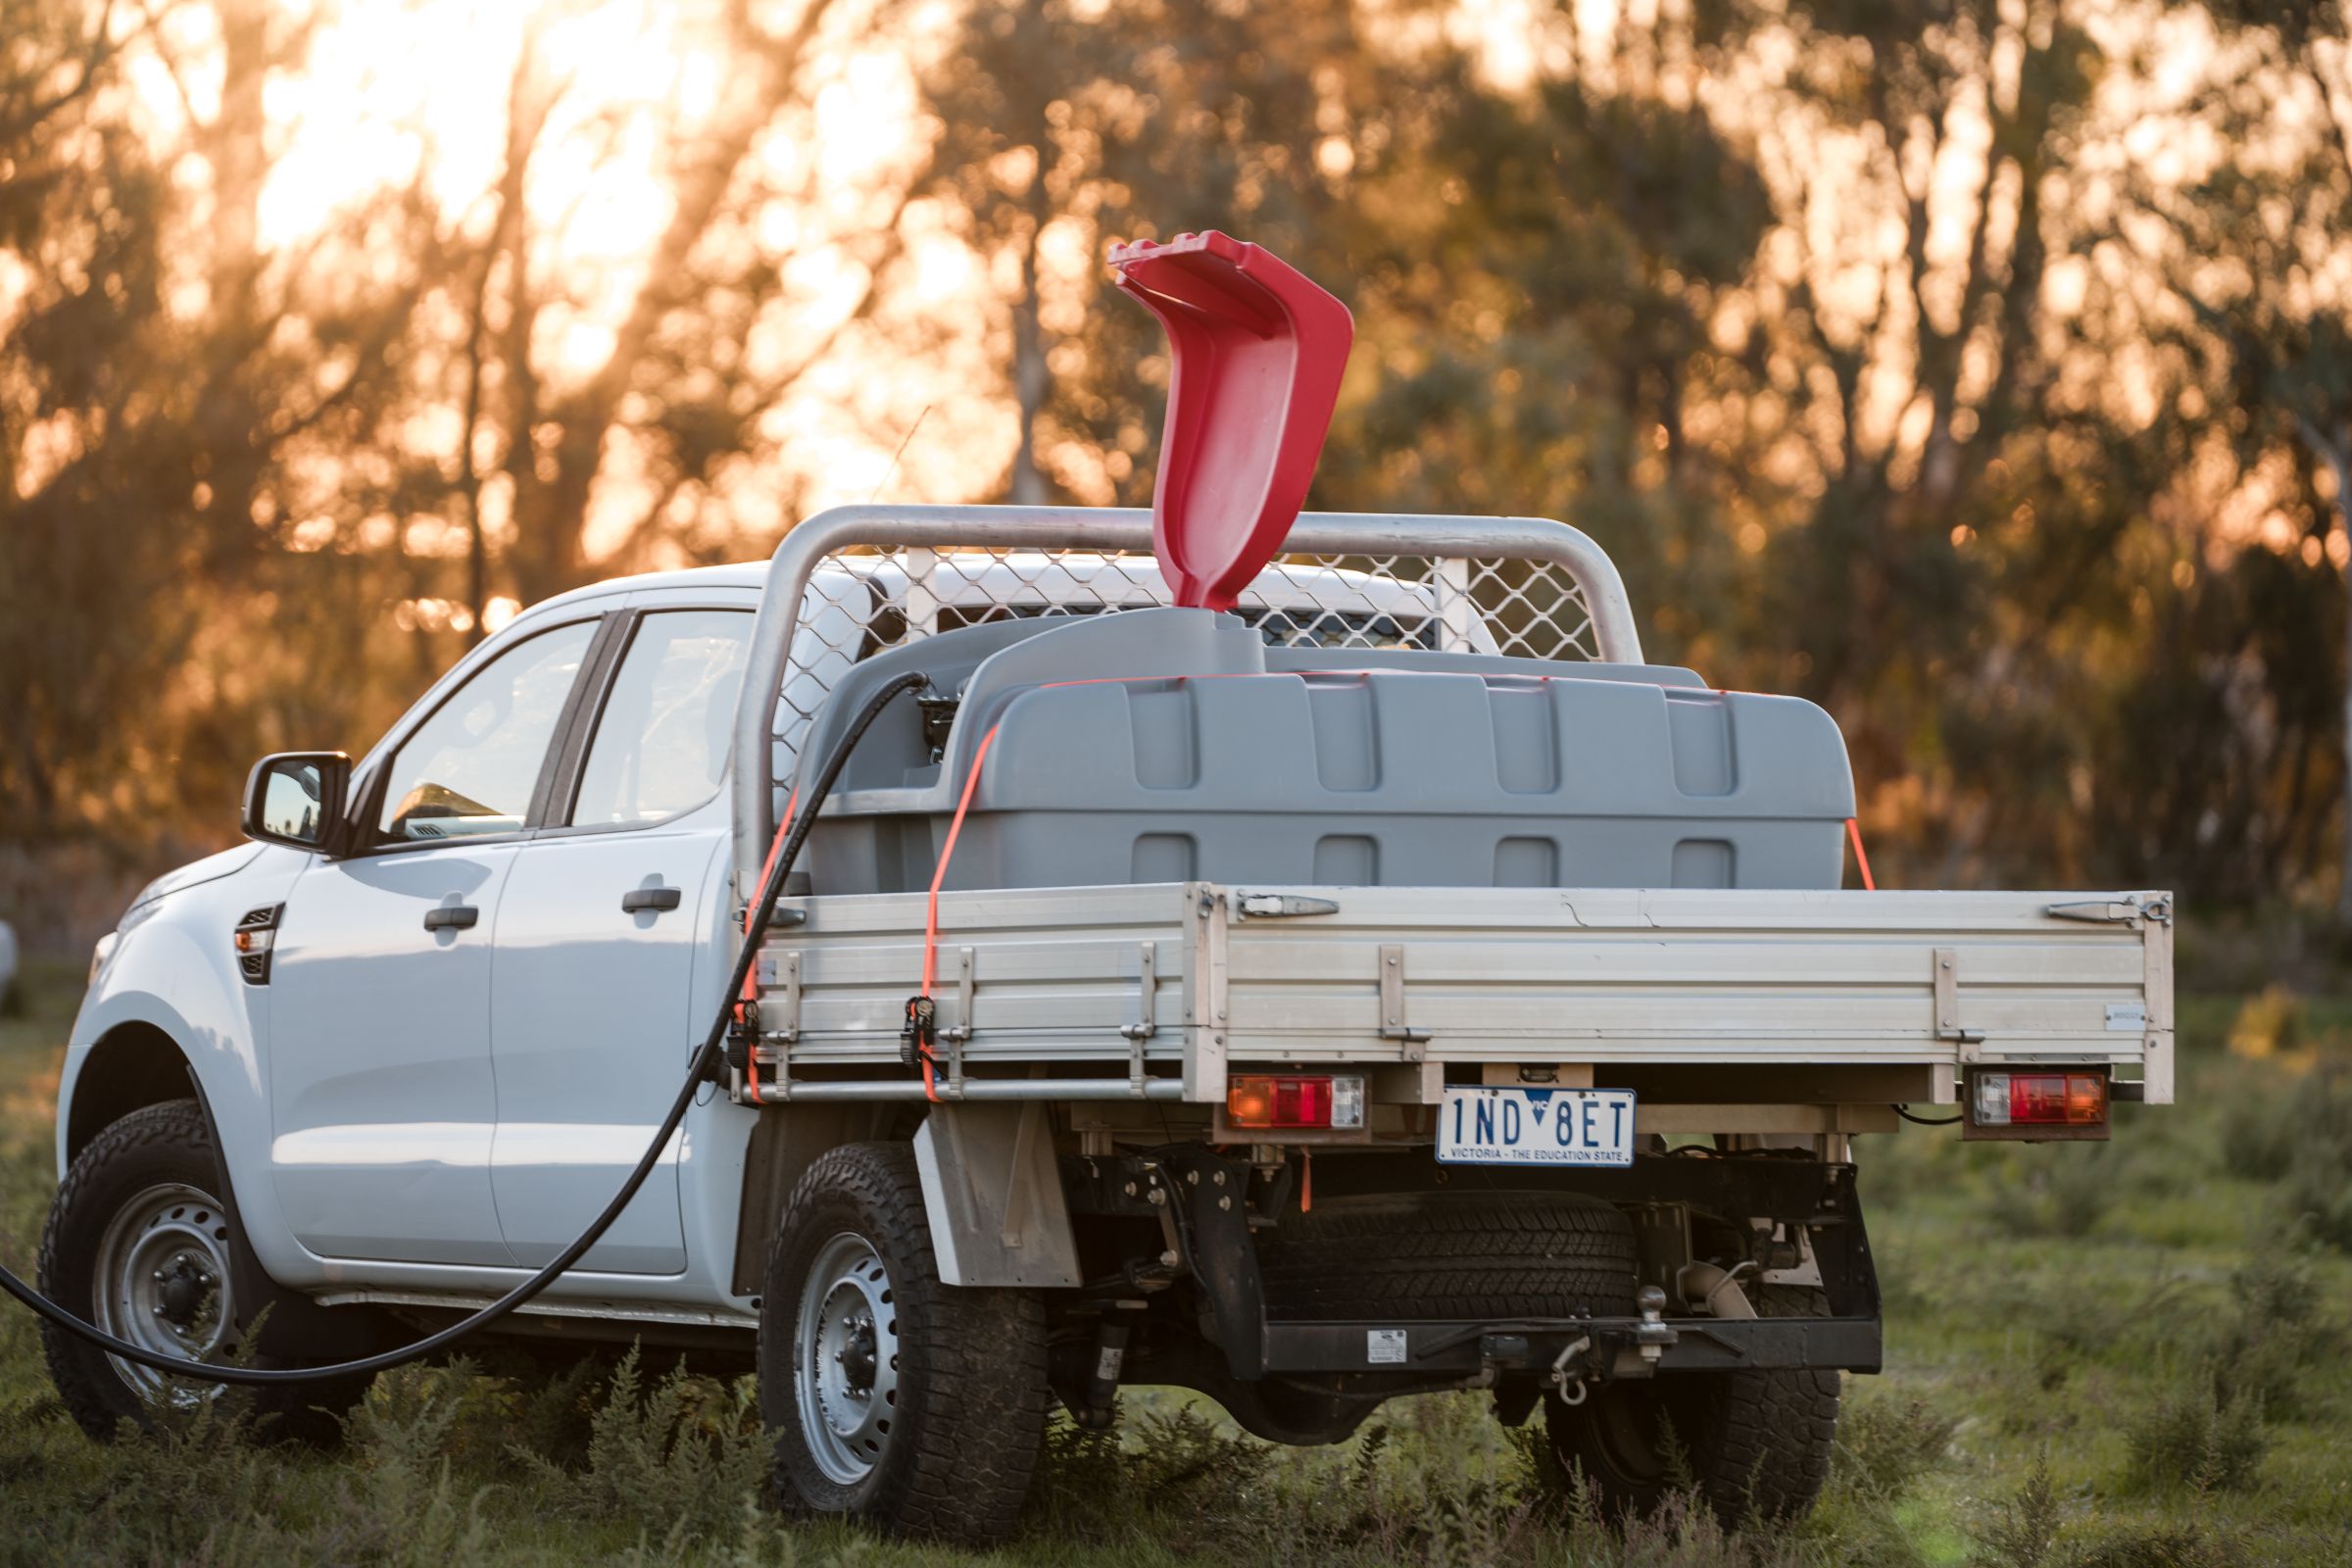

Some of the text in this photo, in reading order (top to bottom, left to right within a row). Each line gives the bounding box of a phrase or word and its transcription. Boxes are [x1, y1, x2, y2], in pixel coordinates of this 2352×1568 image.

[1452, 1098, 1627, 1148] 1ND 8ET
[1450, 1148, 1501, 1158] VICTORIA
[1511, 1149, 1532, 1159] THE
[1534, 1150, 1591, 1161] EDUCATION
[1593, 1151, 1624, 1161] STATE
